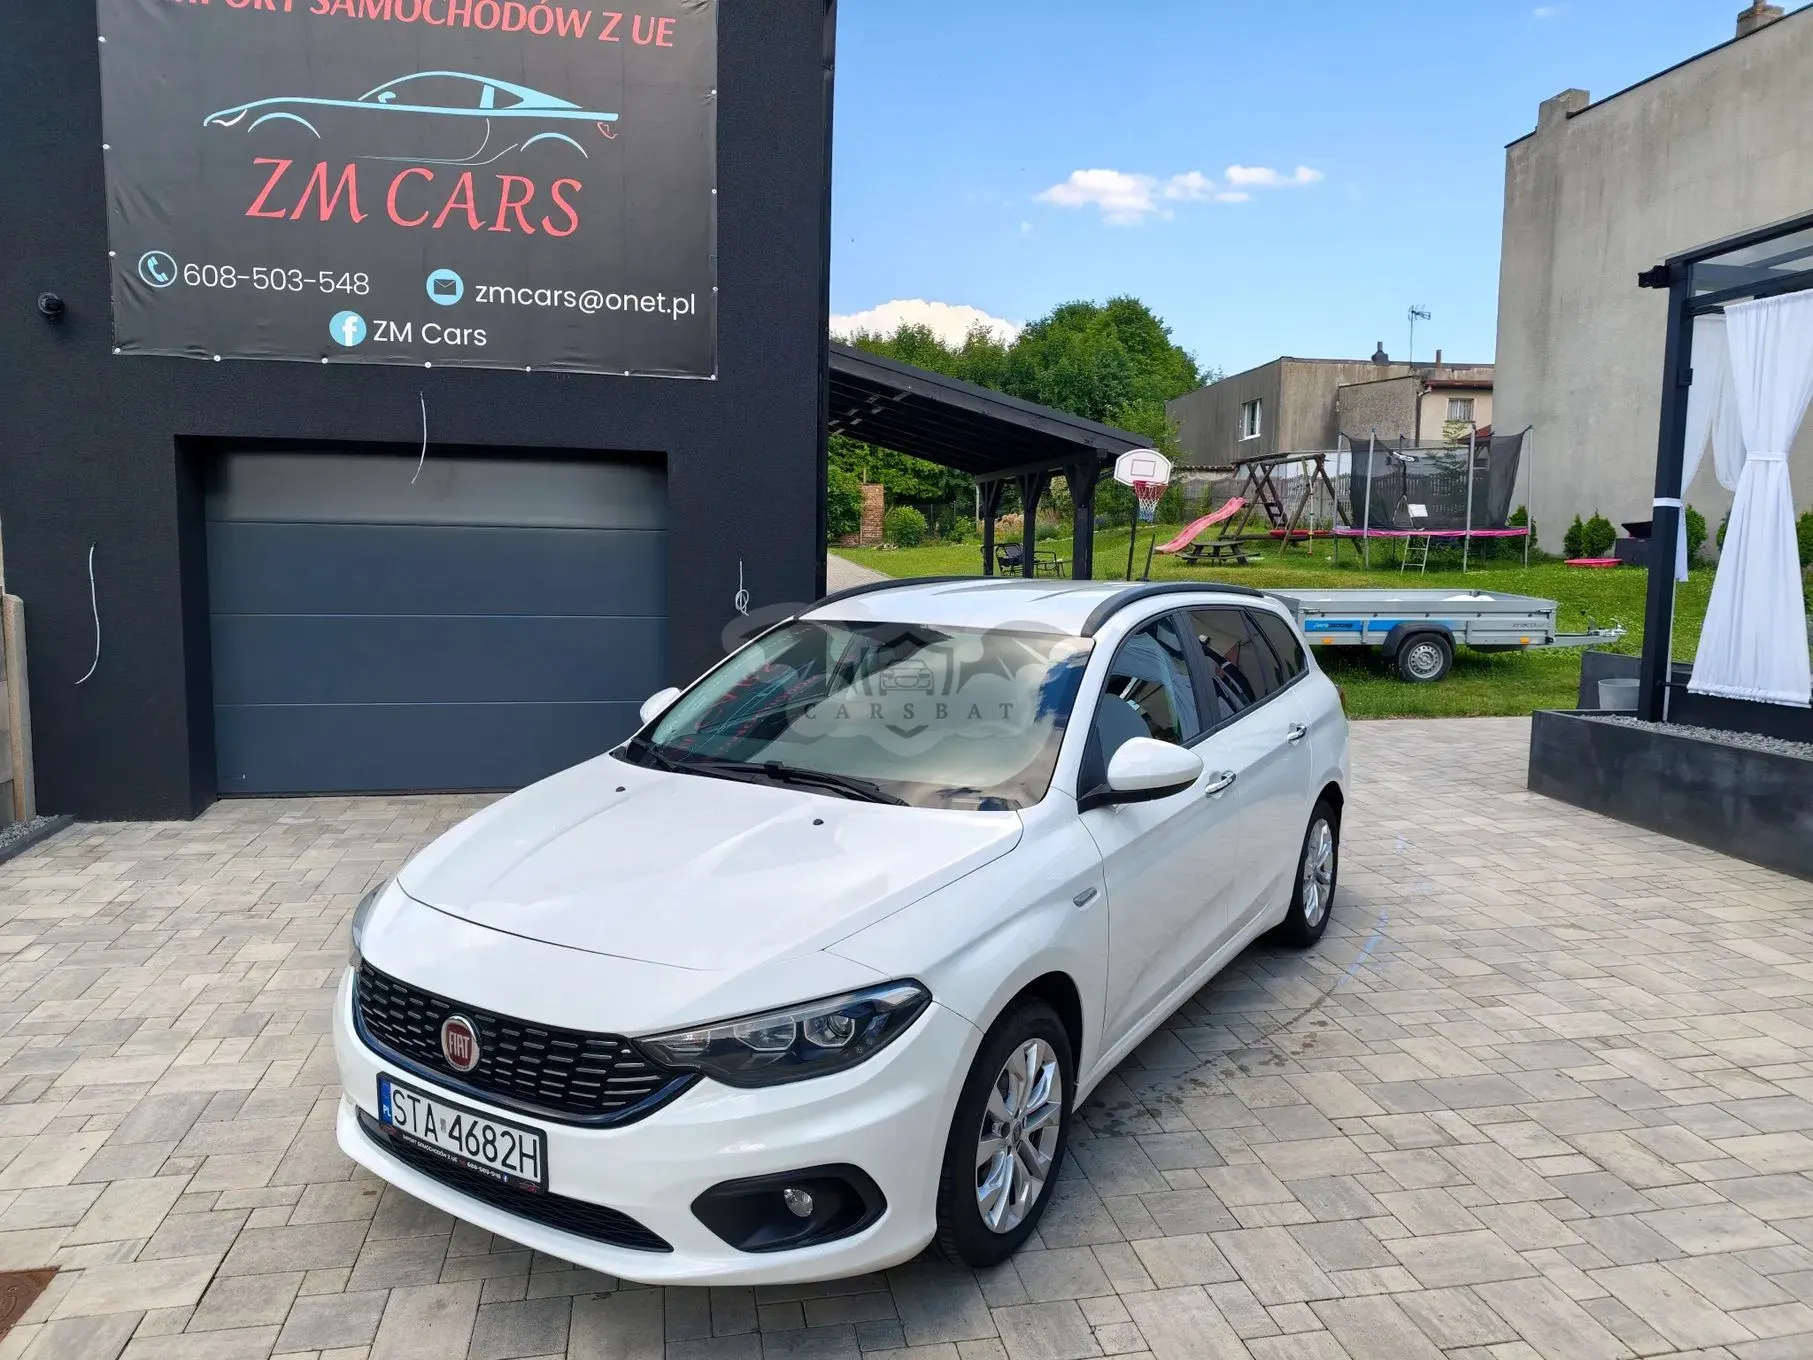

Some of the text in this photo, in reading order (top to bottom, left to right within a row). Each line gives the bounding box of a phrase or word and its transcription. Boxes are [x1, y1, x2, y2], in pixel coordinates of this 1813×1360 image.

[598, 12, 623, 42] Z
[632, 15, 677, 48] UE
[246, 157, 583, 238] ZM CARS
[183, 263, 370, 296] 608-503-548
[475, 284, 696, 320] zmcars@onet.pl
[373, 320, 488, 347] ZM Cars
[448, 1031, 470, 1059] FIAT
[382, 1104, 391, 1117] PL
[392, 1089, 538, 1178] STA 4682H
